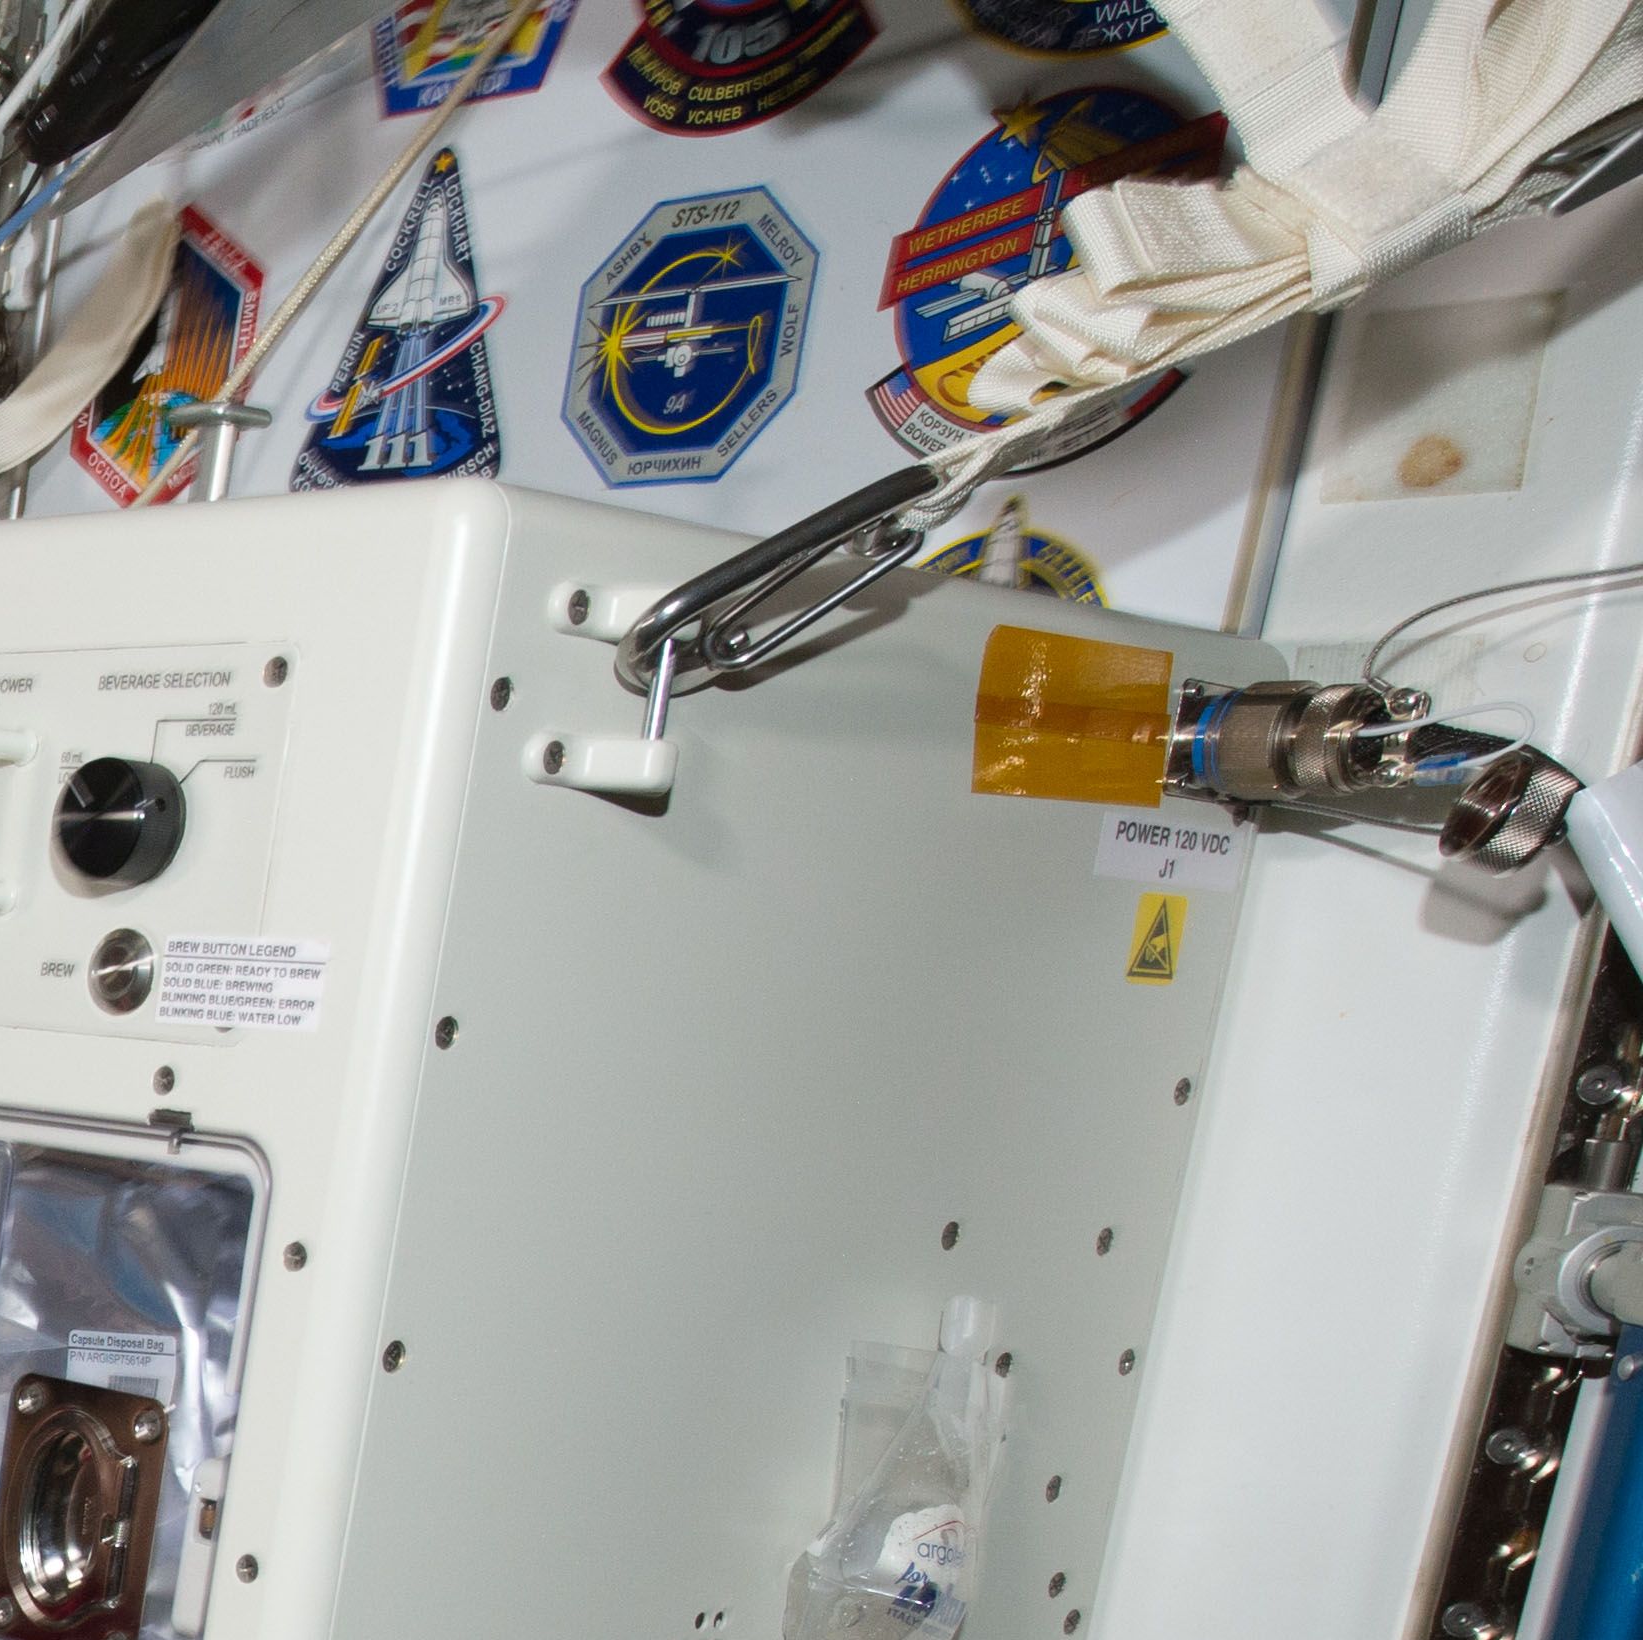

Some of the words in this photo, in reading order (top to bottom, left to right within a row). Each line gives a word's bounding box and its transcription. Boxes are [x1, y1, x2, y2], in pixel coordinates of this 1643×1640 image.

[691, 15, 791, 64] 105
[644, 94, 677, 121] VOSS
[686, 105, 743, 124] УСАЧЕВ
[385, 178, 435, 272] COCKRELL
[444, 171, 473, 264] LOCKHART
[672, 200, 741, 228] STS-112
[909, 197, 1026, 256] WETHERBEE
[756, 214, 803, 267] MELROY
[605, 231, 652, 285] ASHBY
[897, 237, 1019, 294] HERRINGTON
[237, 291, 257, 350] SMITH
[780, 303, 801, 358] WOLF
[332, 332, 366, 393] PERRIN
[717, 388, 779, 458] SELLERS
[917, 401, 965, 444] КОРЗУН
[356, 431, 433, 471] 111
[576, 411, 619, 466] MAGNUS
[87, 451, 129, 500] OCHOA
[626, 456, 702, 476] ЮРЧИХИН
[98, 674, 161, 691] BEVERAGE
[164, 671, 231, 689] SELECTION
[208, 703, 223, 716] 120
[185, 723, 236, 738] BEVERAGE
[223, 765, 256, 779] FLUSH
[1115, 820, 1171, 847] POWER
[1175, 829, 1198, 851] 120
[1201, 832, 1231, 856] VDC
[1158, 858, 1176, 879] J1
[168, 941, 201, 954] BREW
[202, 942, 247, 956] BUTTON
[249, 944, 297, 958] LEGEND
[40, 961, 75, 977] BREW
[165, 962, 194, 973] SOLID
[196, 963, 233, 976] GREEN:
[235, 965, 272, 978] READY
[274, 967, 287, 979] TO
[289, 968, 321, 981] BREW
[163, 977, 192, 989] SOLID
[193, 978, 221, 990] BLUE:
[225, 980, 274, 994] BREWING
[161, 992, 206, 1005] BLINKING
[209, 994, 276, 1009] BLUE/GREEN:
[278, 998, 315, 1011] ERROR
[159, 1006, 204, 1019] BLINKING
[206, 1009, 235, 1022] BLUE:
[238, 1011, 275, 1025] WATER
[277, 1014, 302, 1026] LOW
[69, 1351, 85, 1362] P/N
[70, 1333, 105, 1347] Capsule
[107, 1335, 145, 1350] Disposal
[147, 1338, 165, 1353] Bag
